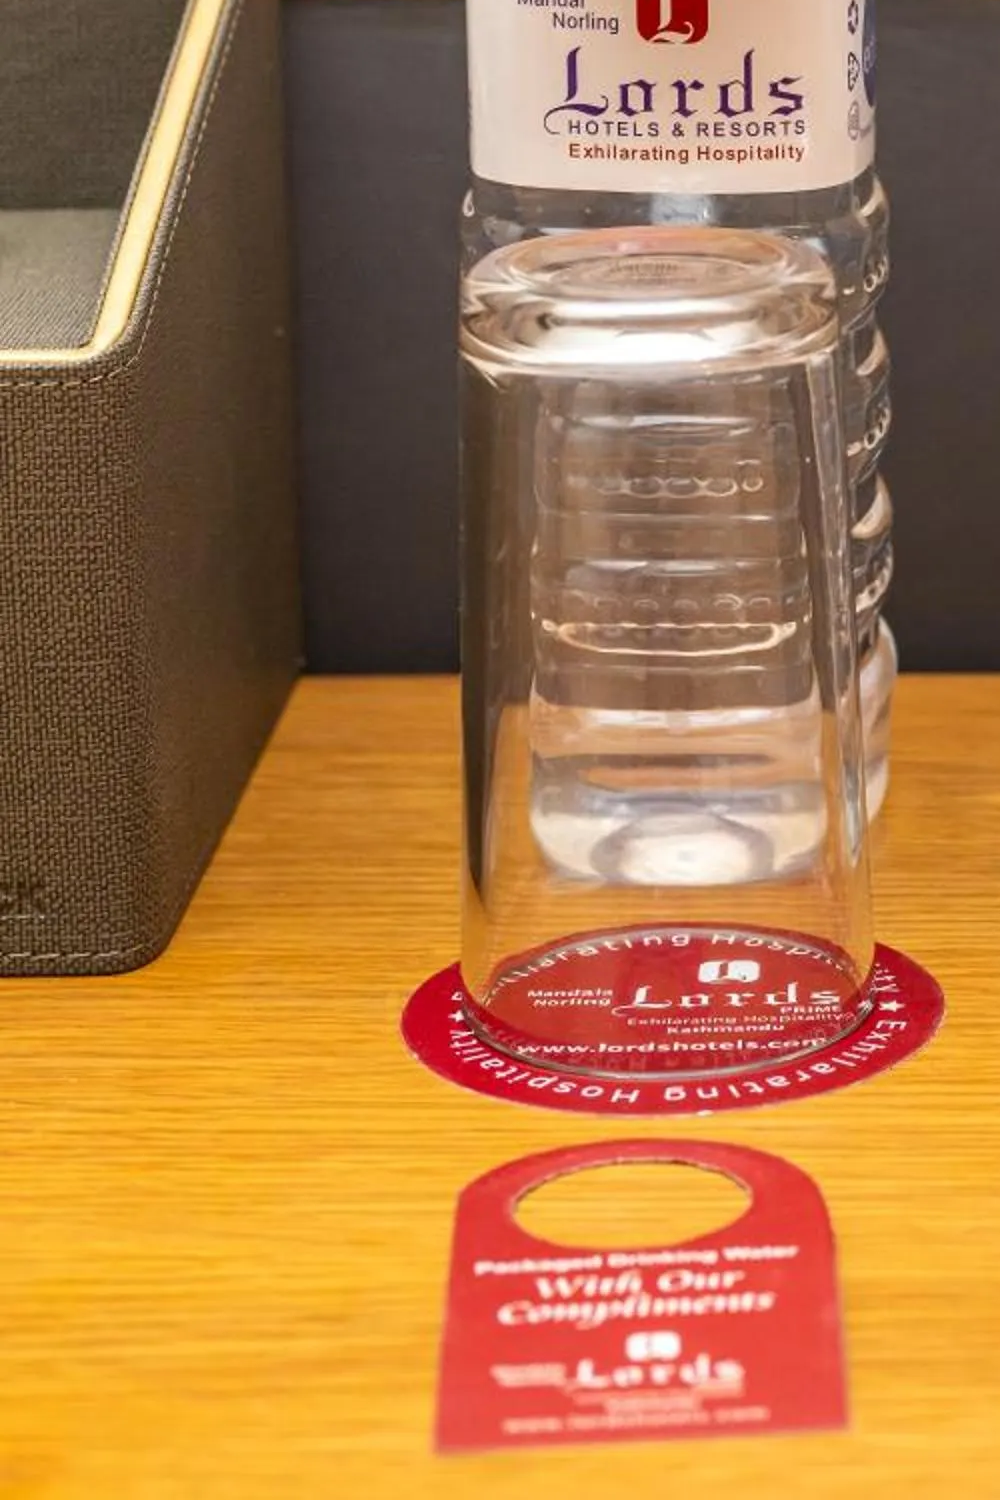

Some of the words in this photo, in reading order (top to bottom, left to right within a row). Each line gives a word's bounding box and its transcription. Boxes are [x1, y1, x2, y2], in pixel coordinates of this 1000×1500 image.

[551, 11, 620, 35] Norling
[543, 45, 806, 135] Lords
[568, 118, 660, 137] HOTELS
[671, 120, 685, 137] &
[696, 118, 806, 137] RESORTS
[568, 143, 690, 165] Exhilarating
[696, 143, 806, 164] Hospitality
[527, 987, 613, 999] Mandala
[534, 997, 612, 1008] Norling
[611, 981, 841, 1017] Lords
[627, 1015, 738, 1027] Exhilarating
[780, 1004, 842, 1015] PRIME
[667, 1023, 785, 1035] Kathmandu
[517, 1037, 828, 1056] www.lordshotels.com
[449, 1029, 640, 1104] Hospitality
[664, 1019, 907, 1101] Exhilarating
[535, 1269, 643, 1299] With
[657, 1269, 746, 1293] Our
[497, 1290, 777, 1329] Compliments
[568, 1353, 746, 1389] Lords
